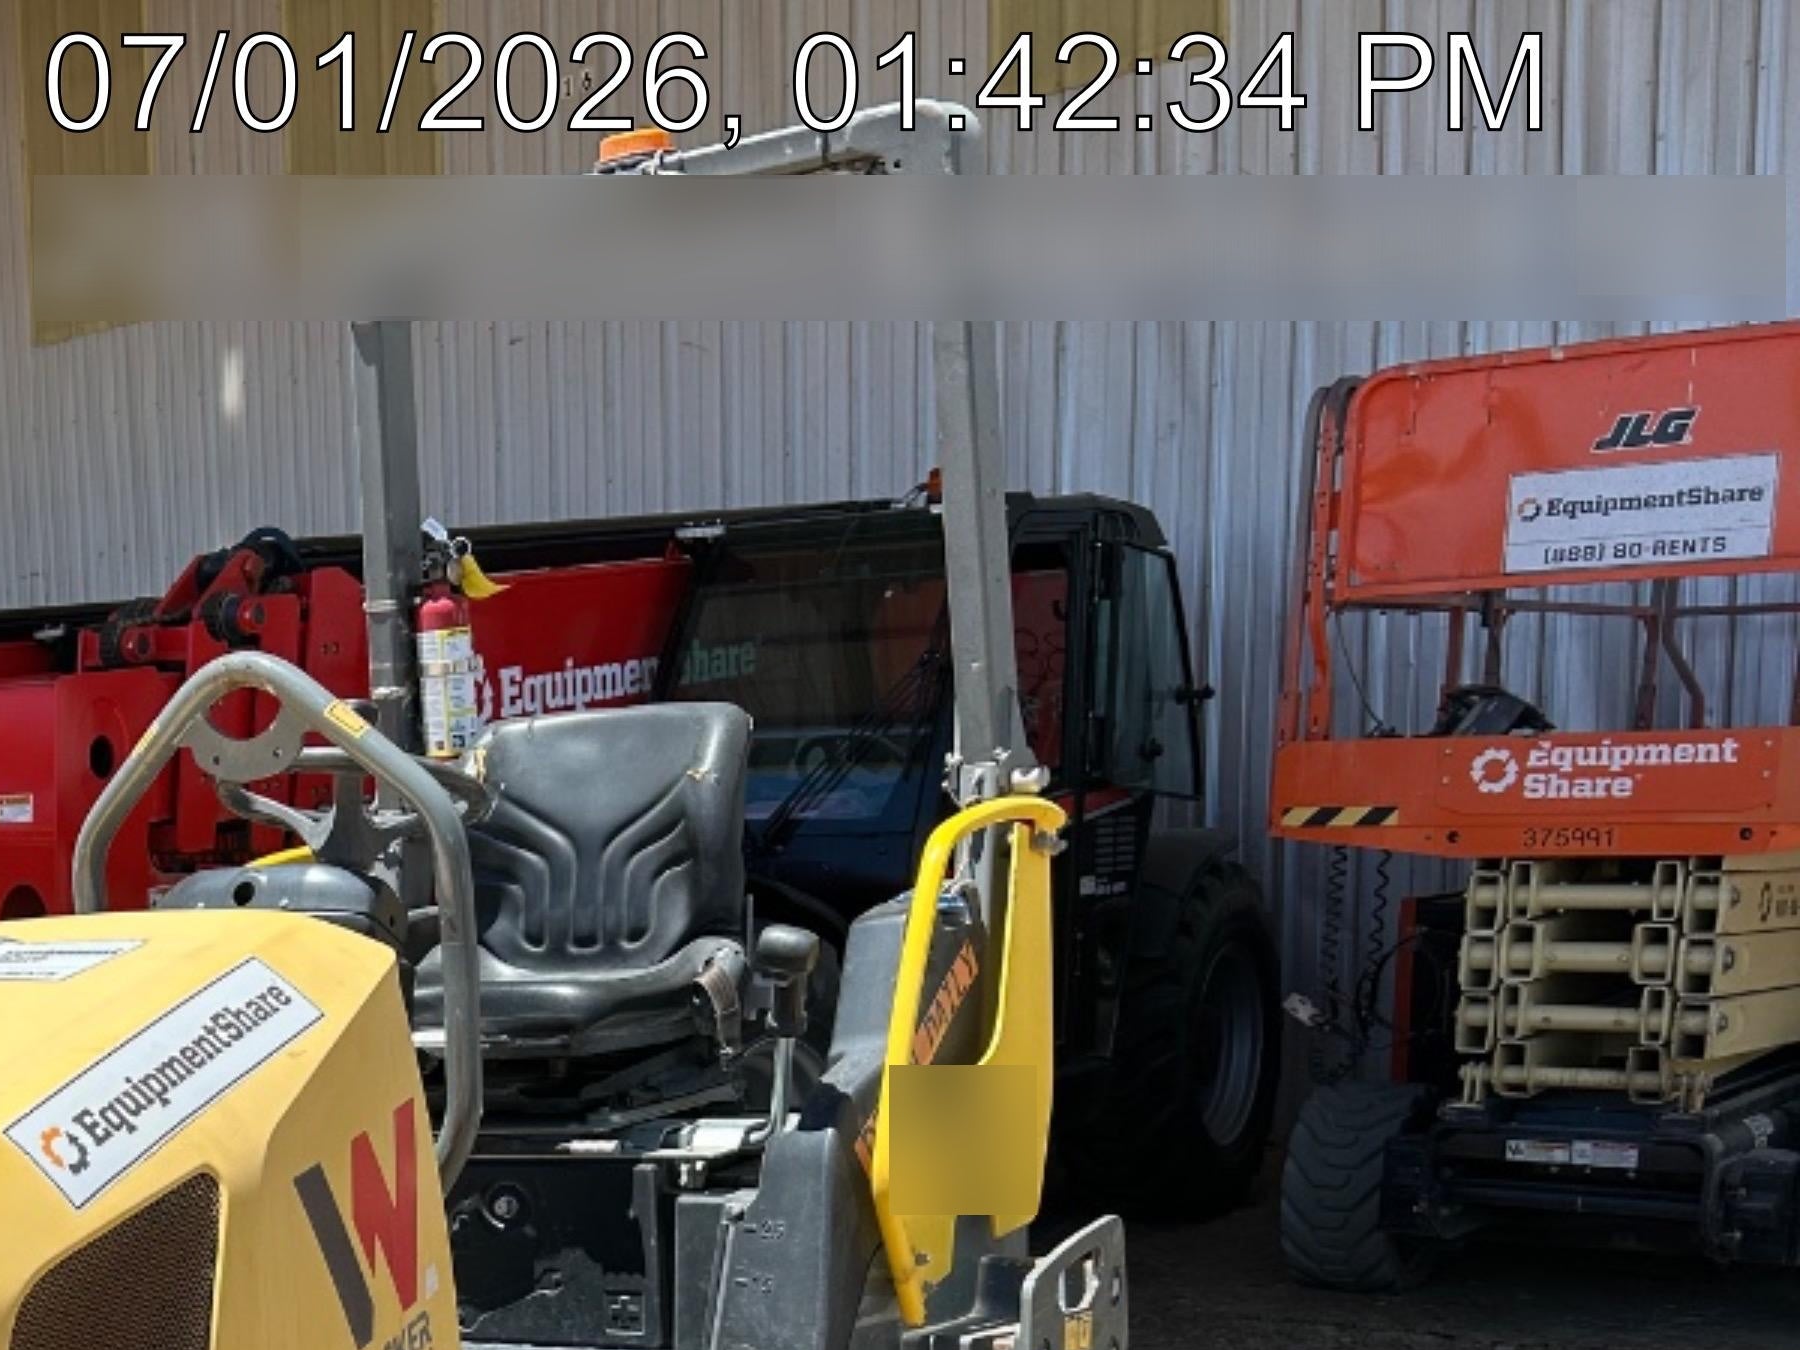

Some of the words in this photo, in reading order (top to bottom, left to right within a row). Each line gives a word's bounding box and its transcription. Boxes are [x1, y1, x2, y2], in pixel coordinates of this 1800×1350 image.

[1592, 408, 1697, 451] JLG
[1544, 485, 1765, 520] EquipmentShare
[499, 656, 659, 716] Equipmen
[1525, 737, 1740, 772] Equipment
[1522, 772, 1633, 799] Share
[1522, 826, 1616, 848] 375991
[70, 984, 293, 1147] EquipmentShare
